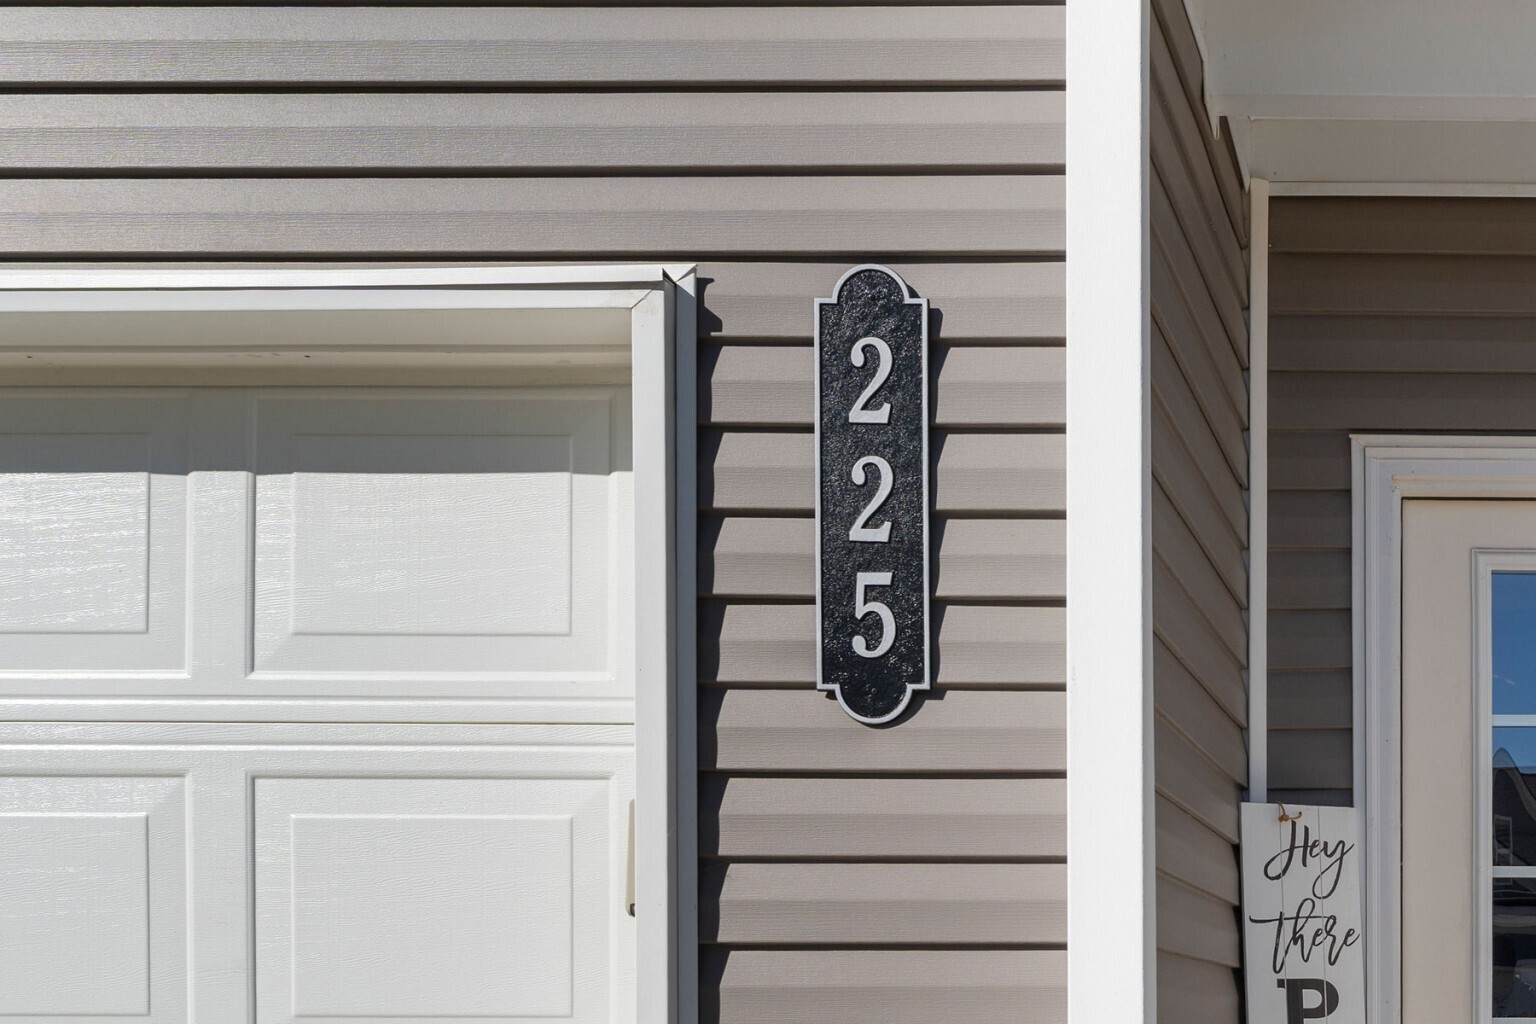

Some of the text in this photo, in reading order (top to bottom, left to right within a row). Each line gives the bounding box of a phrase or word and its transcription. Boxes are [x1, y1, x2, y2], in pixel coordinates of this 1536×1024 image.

[848, 336, 896, 659] 225
[1263, 819, 1354, 899] Hey
[1249, 897, 1360, 974] there
